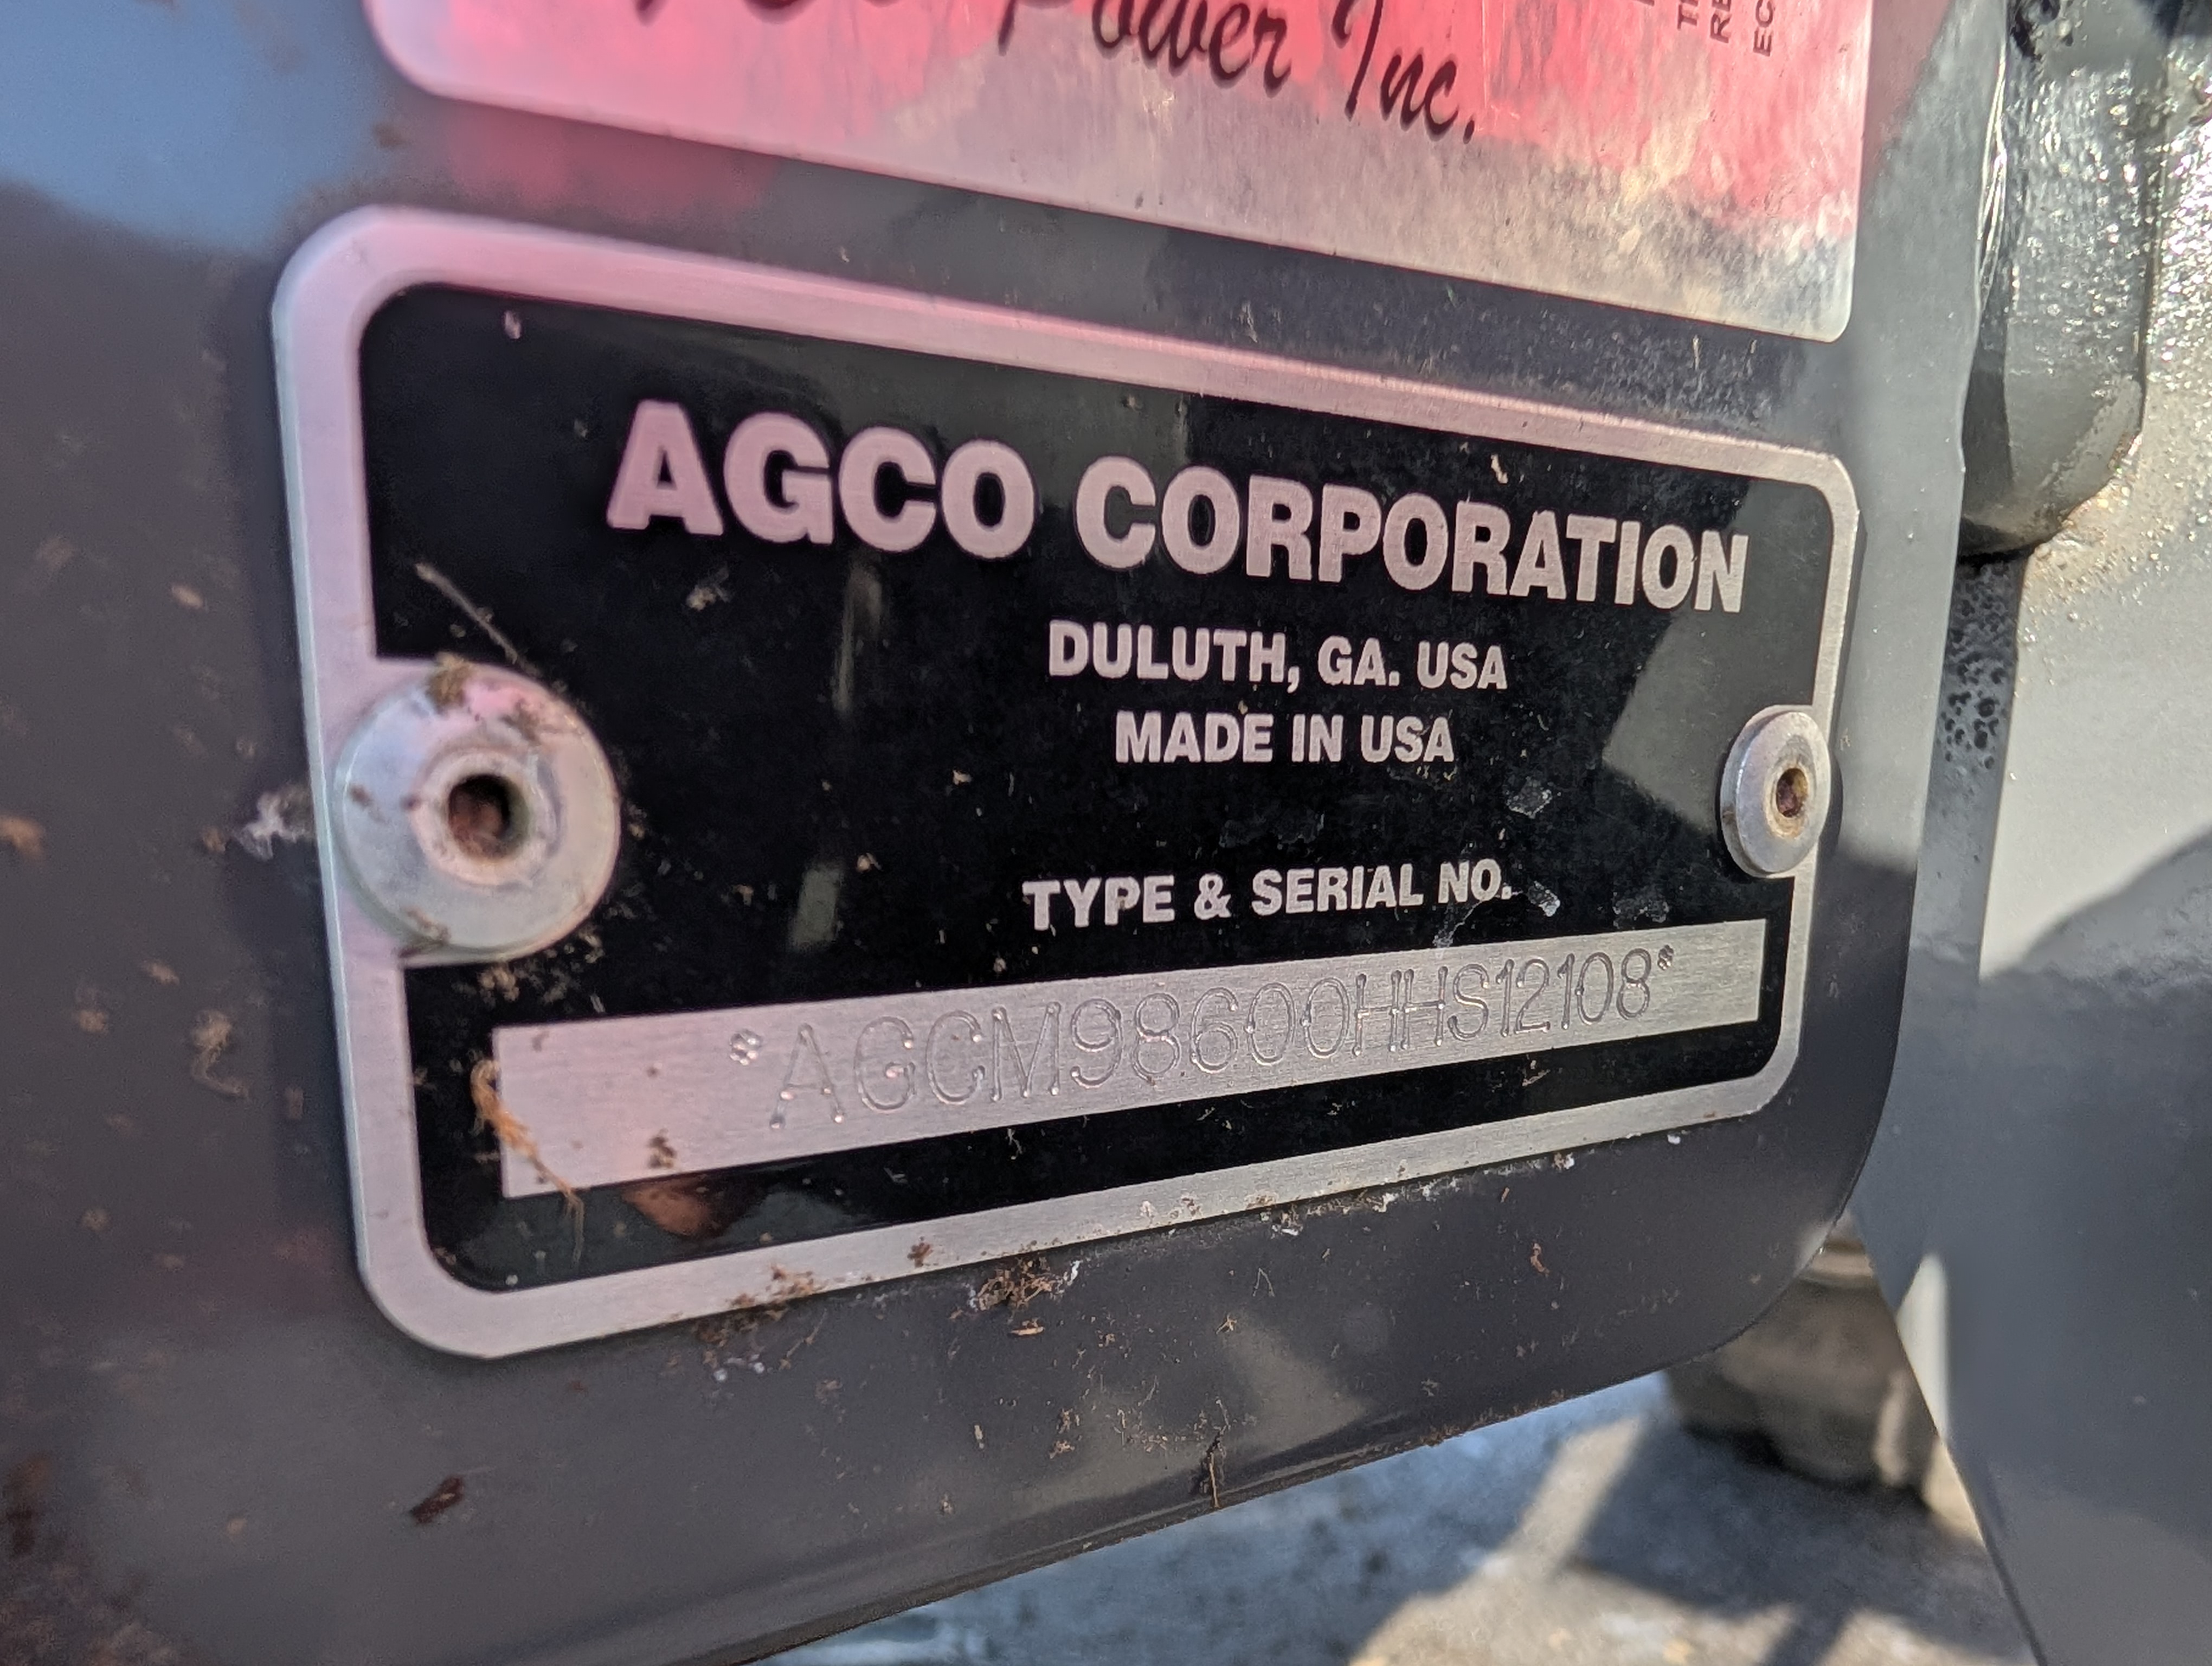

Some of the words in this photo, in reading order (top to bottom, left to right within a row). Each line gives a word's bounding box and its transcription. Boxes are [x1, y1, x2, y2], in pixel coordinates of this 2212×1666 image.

[1332, 0, 1475, 143] Inc.
[606, 399, 1036, 559] AGCO
[1076, 455, 1750, 613] CORPORATION
[1049, 619, 1300, 693] DULUTH,
[1317, 636, 1400, 686] GA.
[1417, 640, 1508, 689] USA
[1115, 710, 1274, 762] MADE
[1292, 714, 1343, 762] IN
[1360, 715, 1455, 762] USA
[1022, 875, 1175, 931] TYPE
[1193, 873, 1231, 920] &
[1251, 863, 1424, 916] SERIAL
[1438, 858, 1512, 904] NO.
